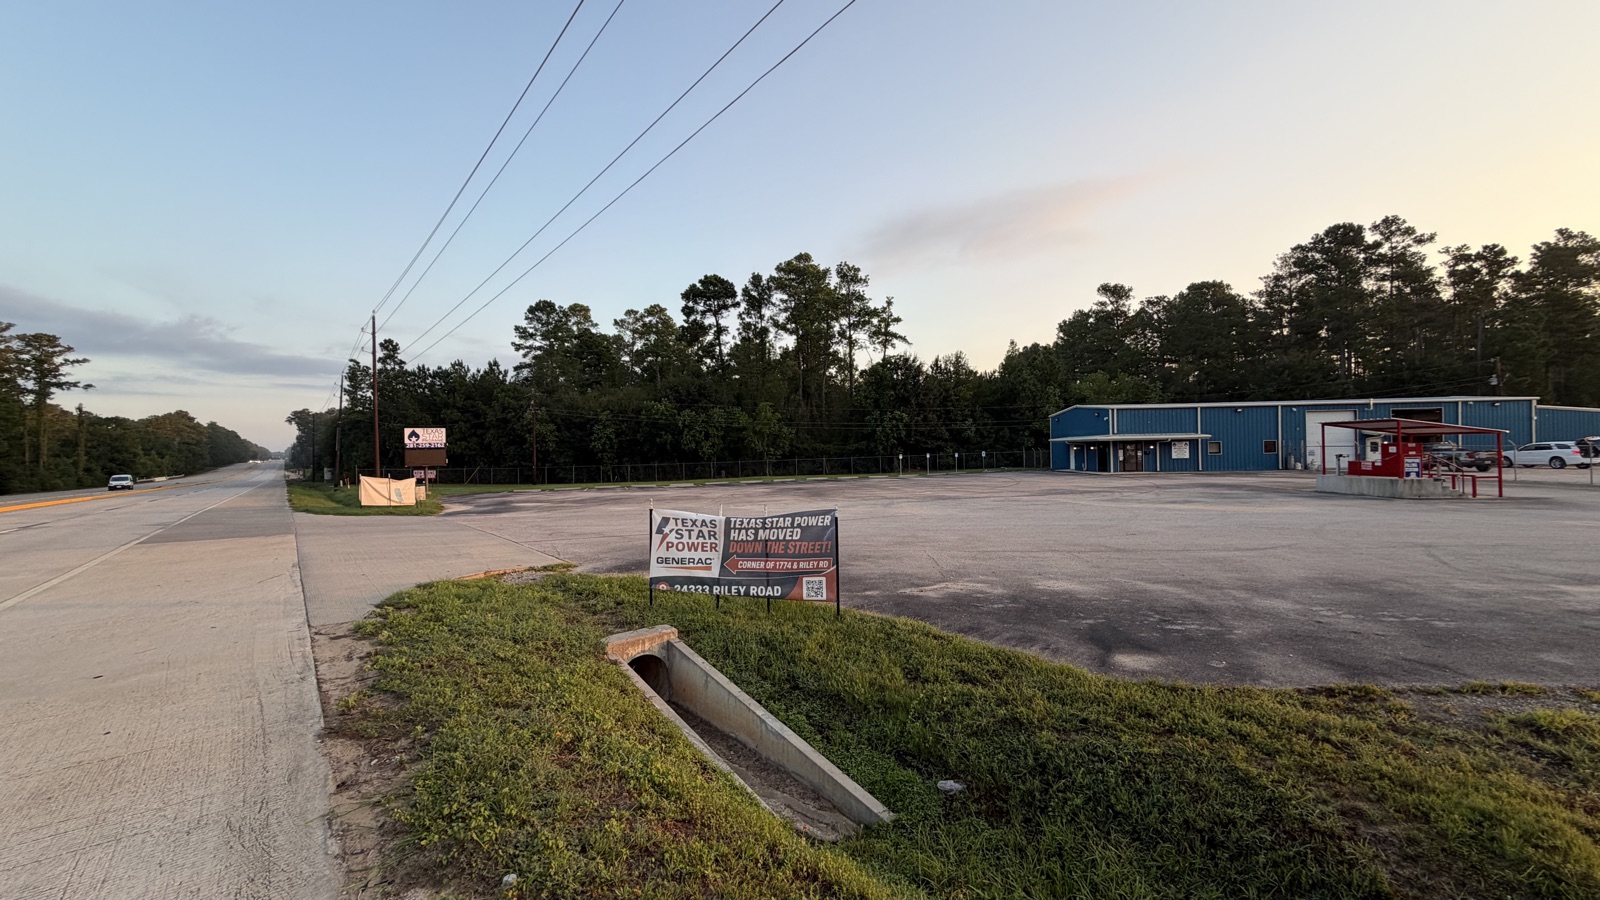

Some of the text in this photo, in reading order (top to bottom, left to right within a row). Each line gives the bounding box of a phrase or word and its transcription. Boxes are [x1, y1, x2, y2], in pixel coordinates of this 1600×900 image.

[672, 518, 717, 528] TEXAS
[730, 515, 831, 528] TEXAS STAR POWER
[675, 528, 718, 540] STAR
[730, 528, 801, 541] HAS MOVED
[666, 541, 718, 553] POWER
[729, 541, 831, 553] DOWN THE STREET!
[656, 557, 713, 565] GENERAC
[738, 561, 765, 569] CORNER
[766, 561, 775, 569] OF
[776, 561, 791, 569] 1774
[793, 561, 798, 569] &
[799, 561, 818, 569] RILEY
[713, 586, 746, 596] RILEY
[750, 586, 781, 596] ROAD
